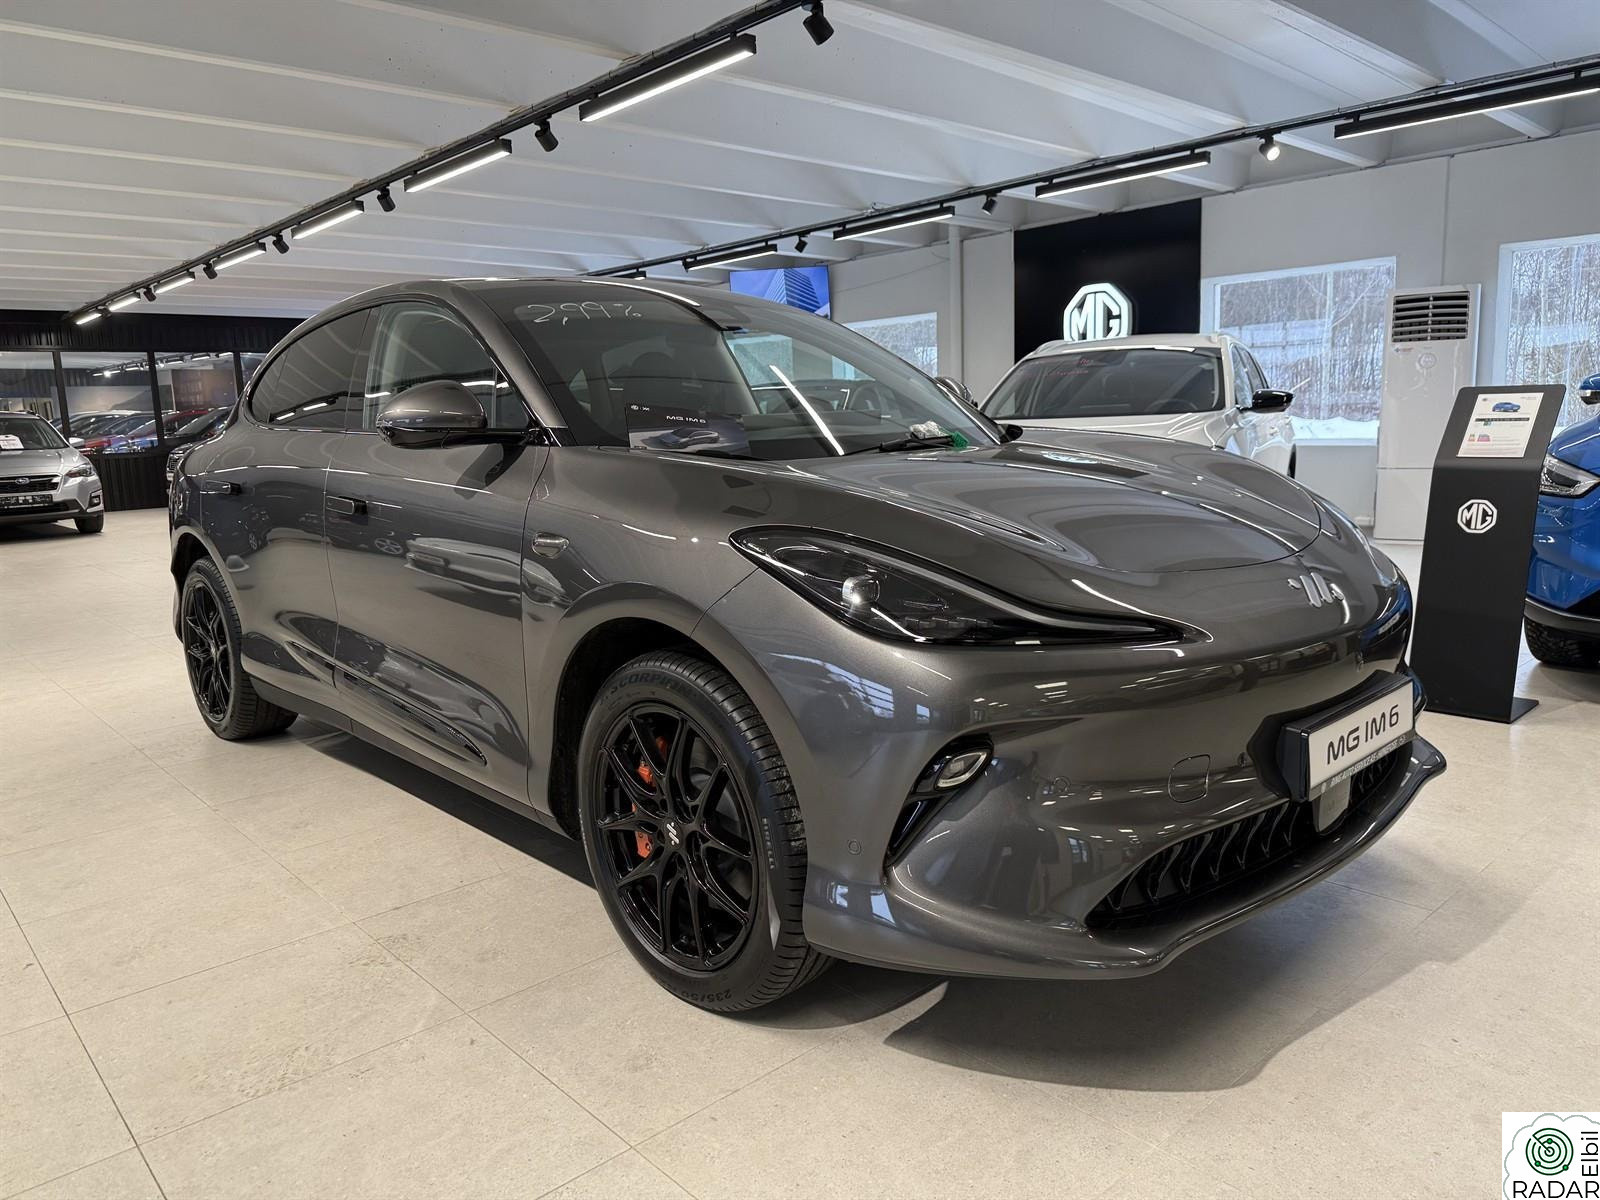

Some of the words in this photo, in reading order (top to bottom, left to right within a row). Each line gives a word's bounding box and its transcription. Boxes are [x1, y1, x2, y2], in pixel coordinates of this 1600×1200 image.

[1067, 290, 1123, 342] MG
[1459, 501, 1495, 532] MG
[1327, 726, 1360, 765] MG
